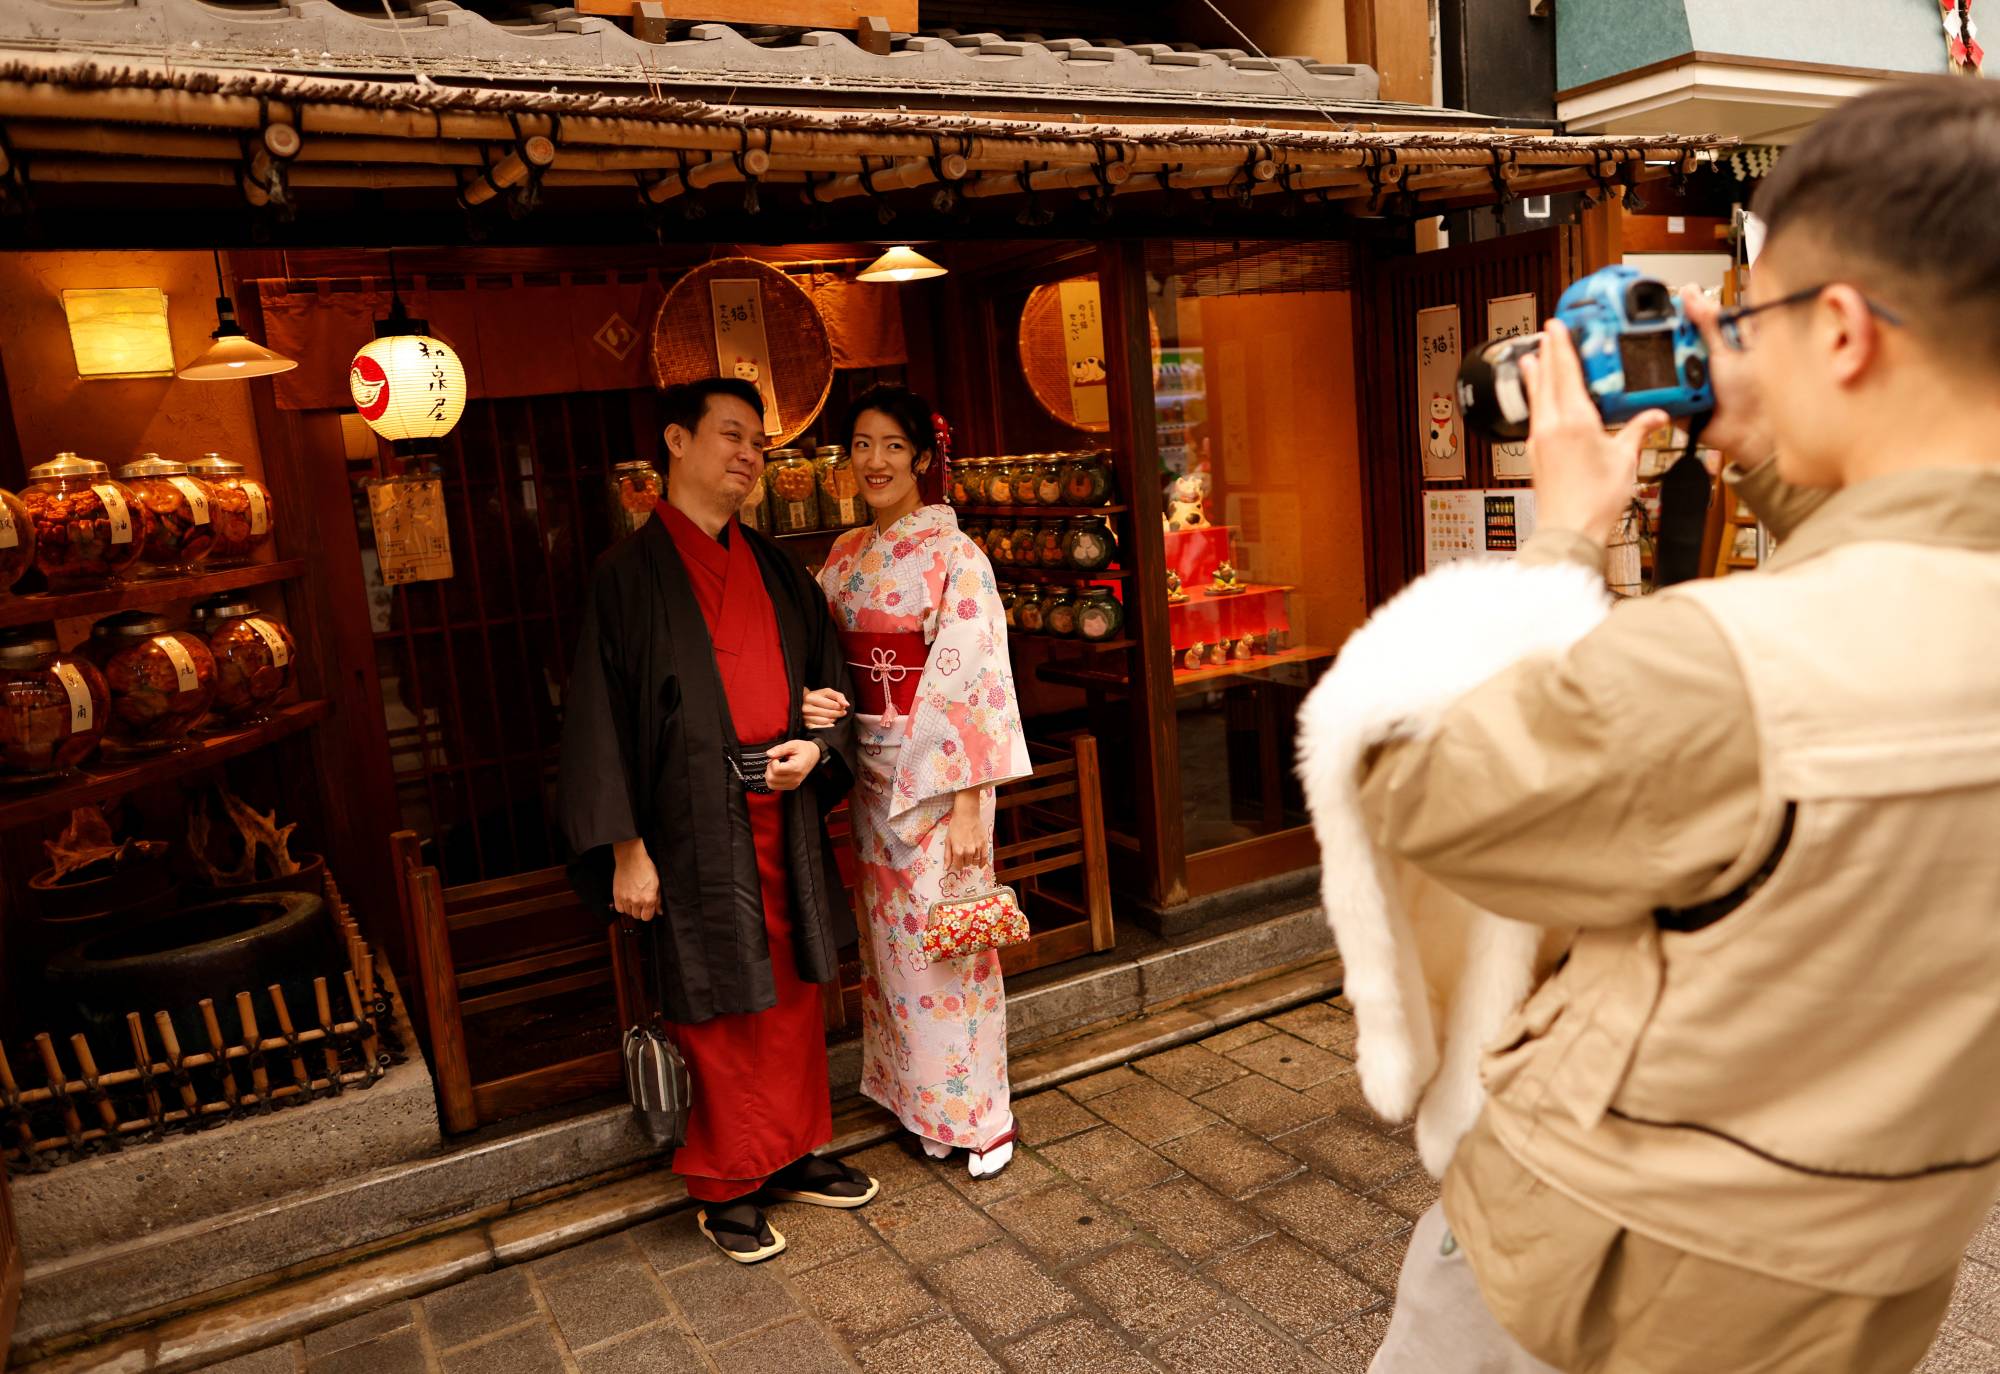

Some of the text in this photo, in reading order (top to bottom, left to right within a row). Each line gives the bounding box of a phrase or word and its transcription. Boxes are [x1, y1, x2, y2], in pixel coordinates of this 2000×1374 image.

[719, 304, 731, 333] せんべい
[730, 304, 748, 322] 猫
[1422, 336, 1433, 367] せんべい
[1432, 334, 1448, 354] 猫
